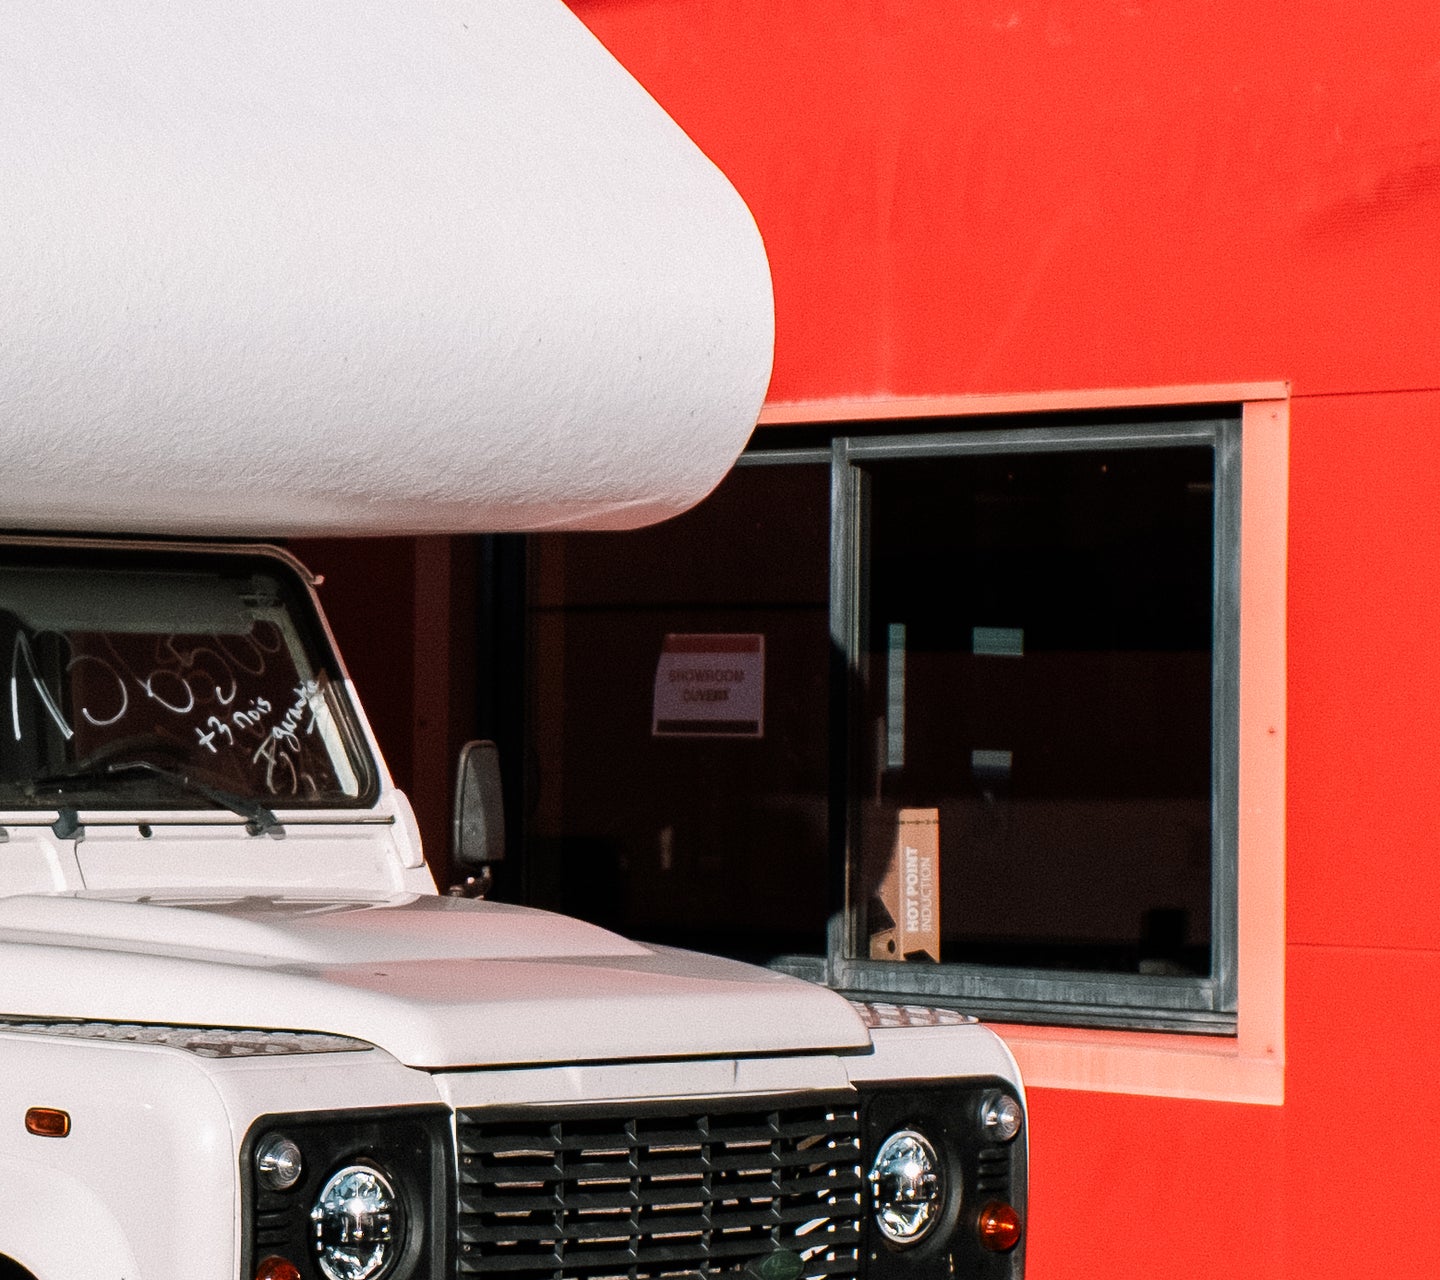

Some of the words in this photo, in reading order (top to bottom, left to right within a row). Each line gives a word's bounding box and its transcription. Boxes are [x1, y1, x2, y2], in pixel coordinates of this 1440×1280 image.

[668, 668, 745, 683] SHOWROOM
[905, 846, 919, 897] POINT
[905, 898, 919, 933] HOT
[920, 856, 932, 933] INDUCTION
